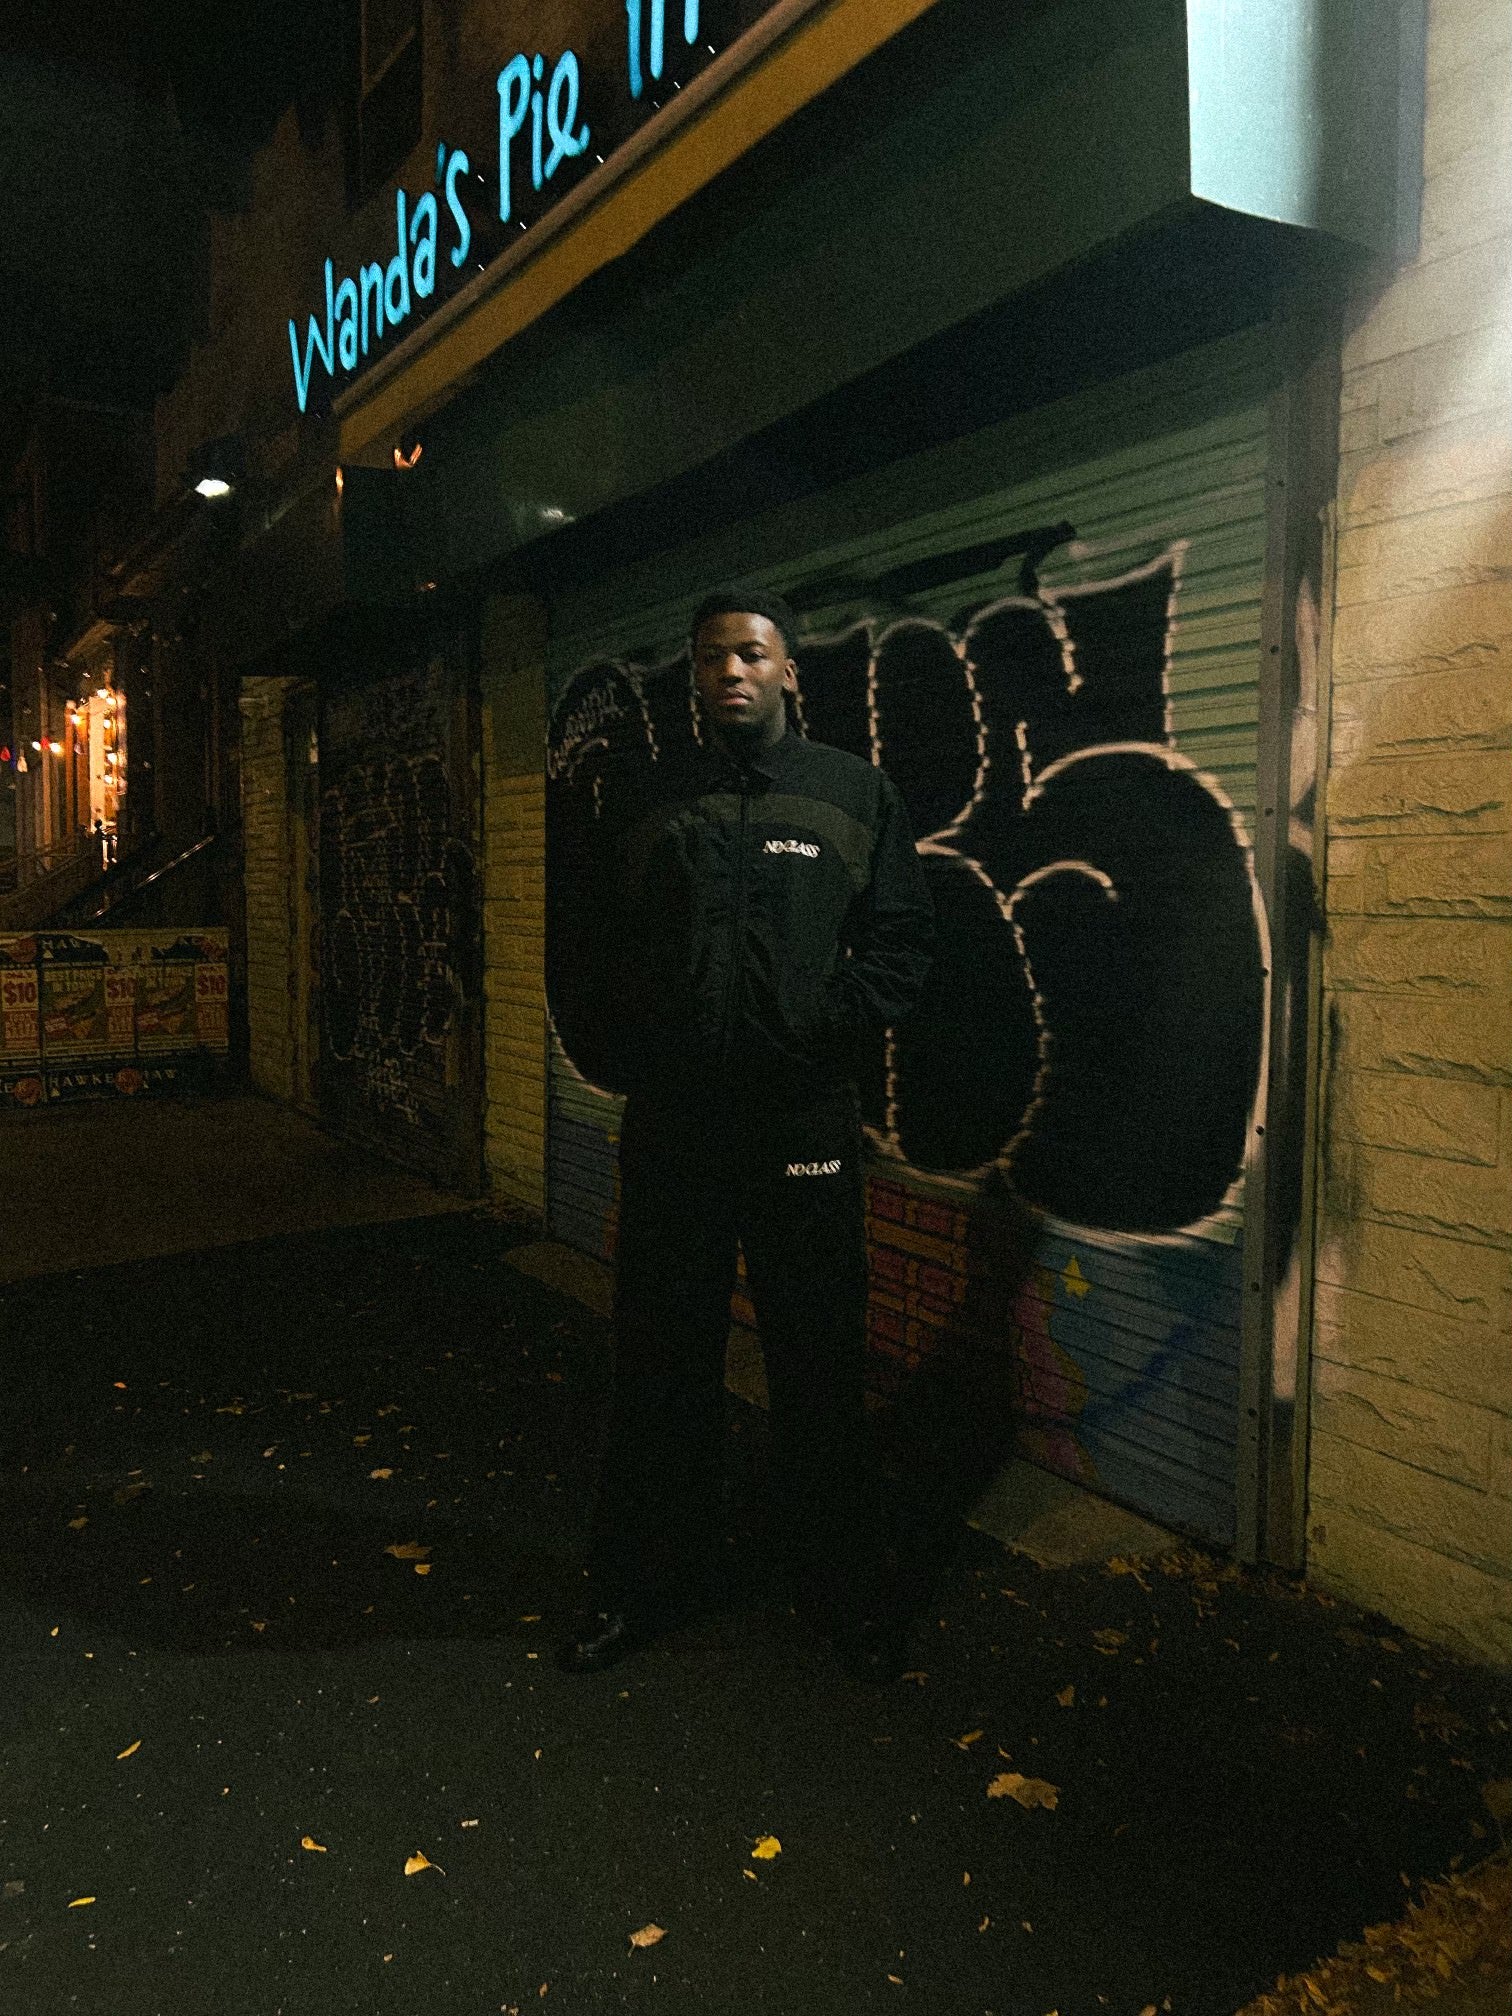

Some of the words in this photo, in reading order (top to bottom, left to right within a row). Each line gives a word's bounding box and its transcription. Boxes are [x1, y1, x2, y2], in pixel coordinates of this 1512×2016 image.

[288, 140, 471, 414] Wanda's
[496, 49, 590, 224] Pie
[4, 982, 36, 1006] $10
